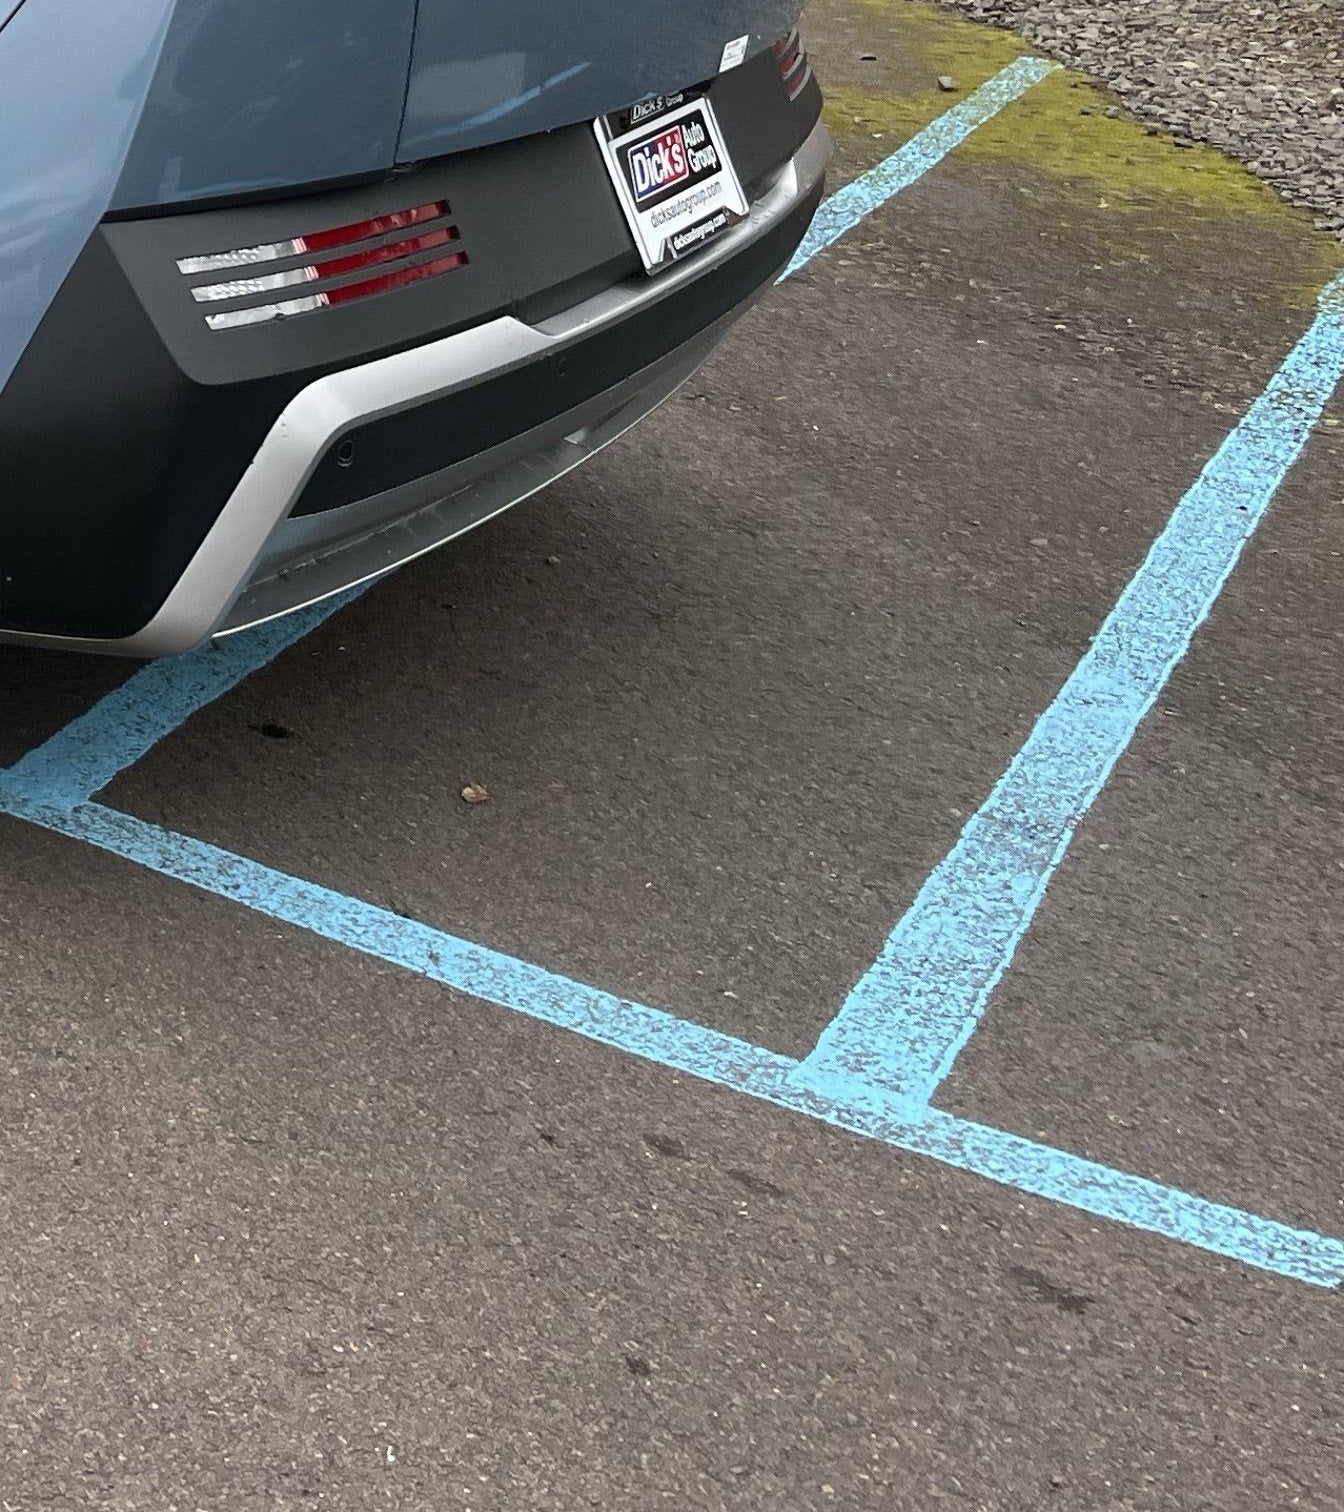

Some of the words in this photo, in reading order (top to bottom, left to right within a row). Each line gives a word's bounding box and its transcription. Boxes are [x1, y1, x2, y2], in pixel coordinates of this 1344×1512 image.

[681, 121, 705, 148] Auto
[633, 135, 684, 193] Dick's
[688, 145, 717, 172] Group
[651, 181, 723, 228] dicksautogroup.com
